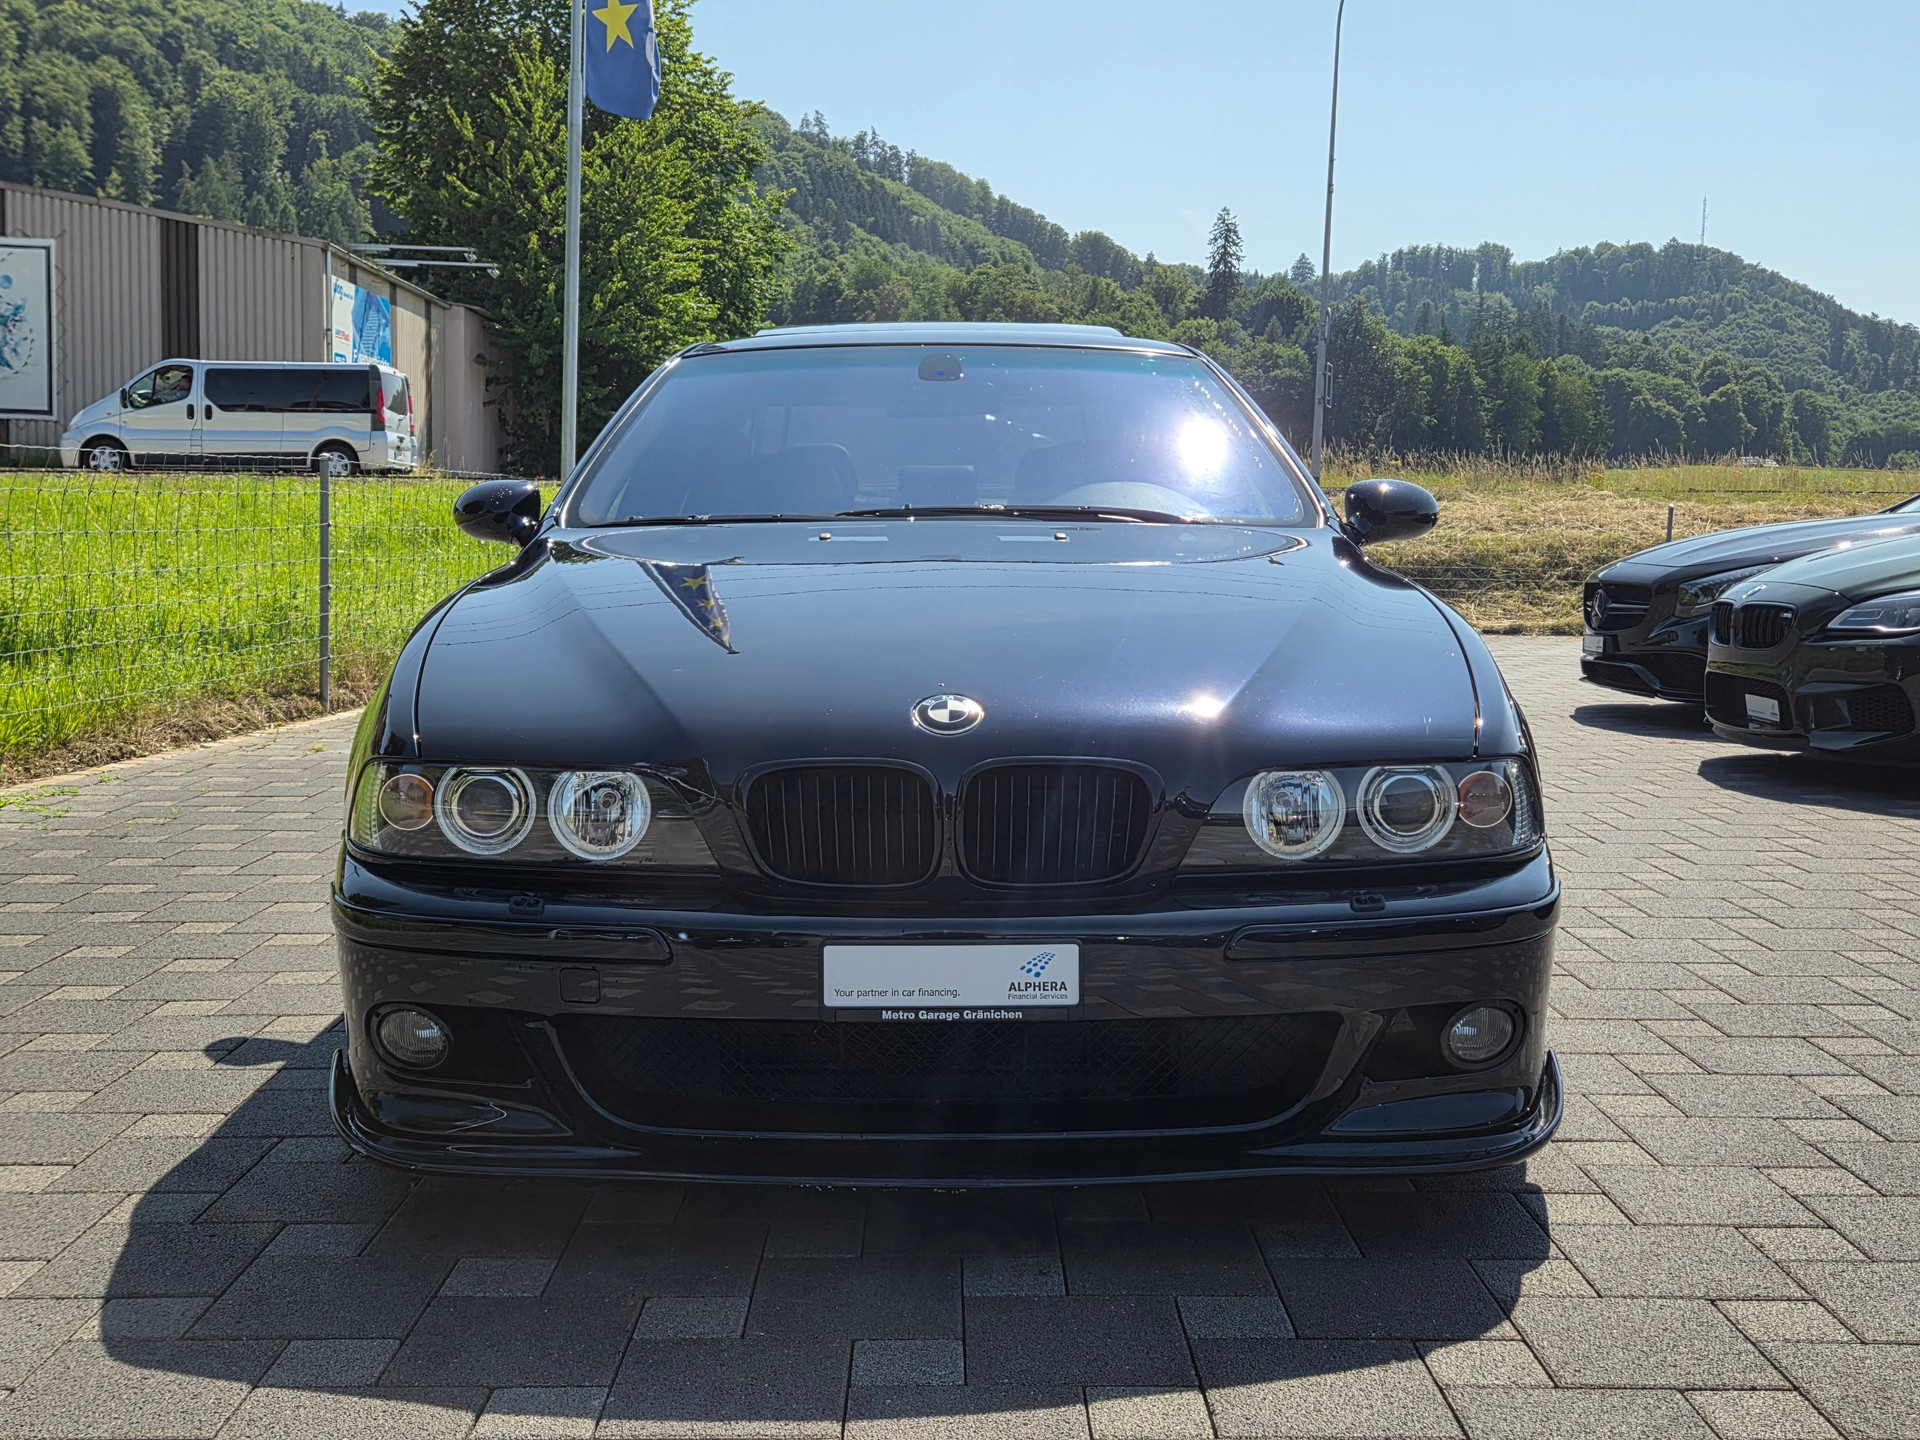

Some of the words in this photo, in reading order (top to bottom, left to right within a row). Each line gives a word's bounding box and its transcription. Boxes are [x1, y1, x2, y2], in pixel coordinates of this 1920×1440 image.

[1008, 981, 1068, 992] ALPHERA
[834, 988, 855, 998] Your
[856, 989, 888, 999] partner
[891, 988, 899, 997] in
[902, 989, 916, 997] car
[918, 988, 961, 999] financing.
[882, 1010, 916, 1020] Metro
[918, 1010, 960, 1021] Garage
[963, 1009, 1023, 1020] Gränichen
